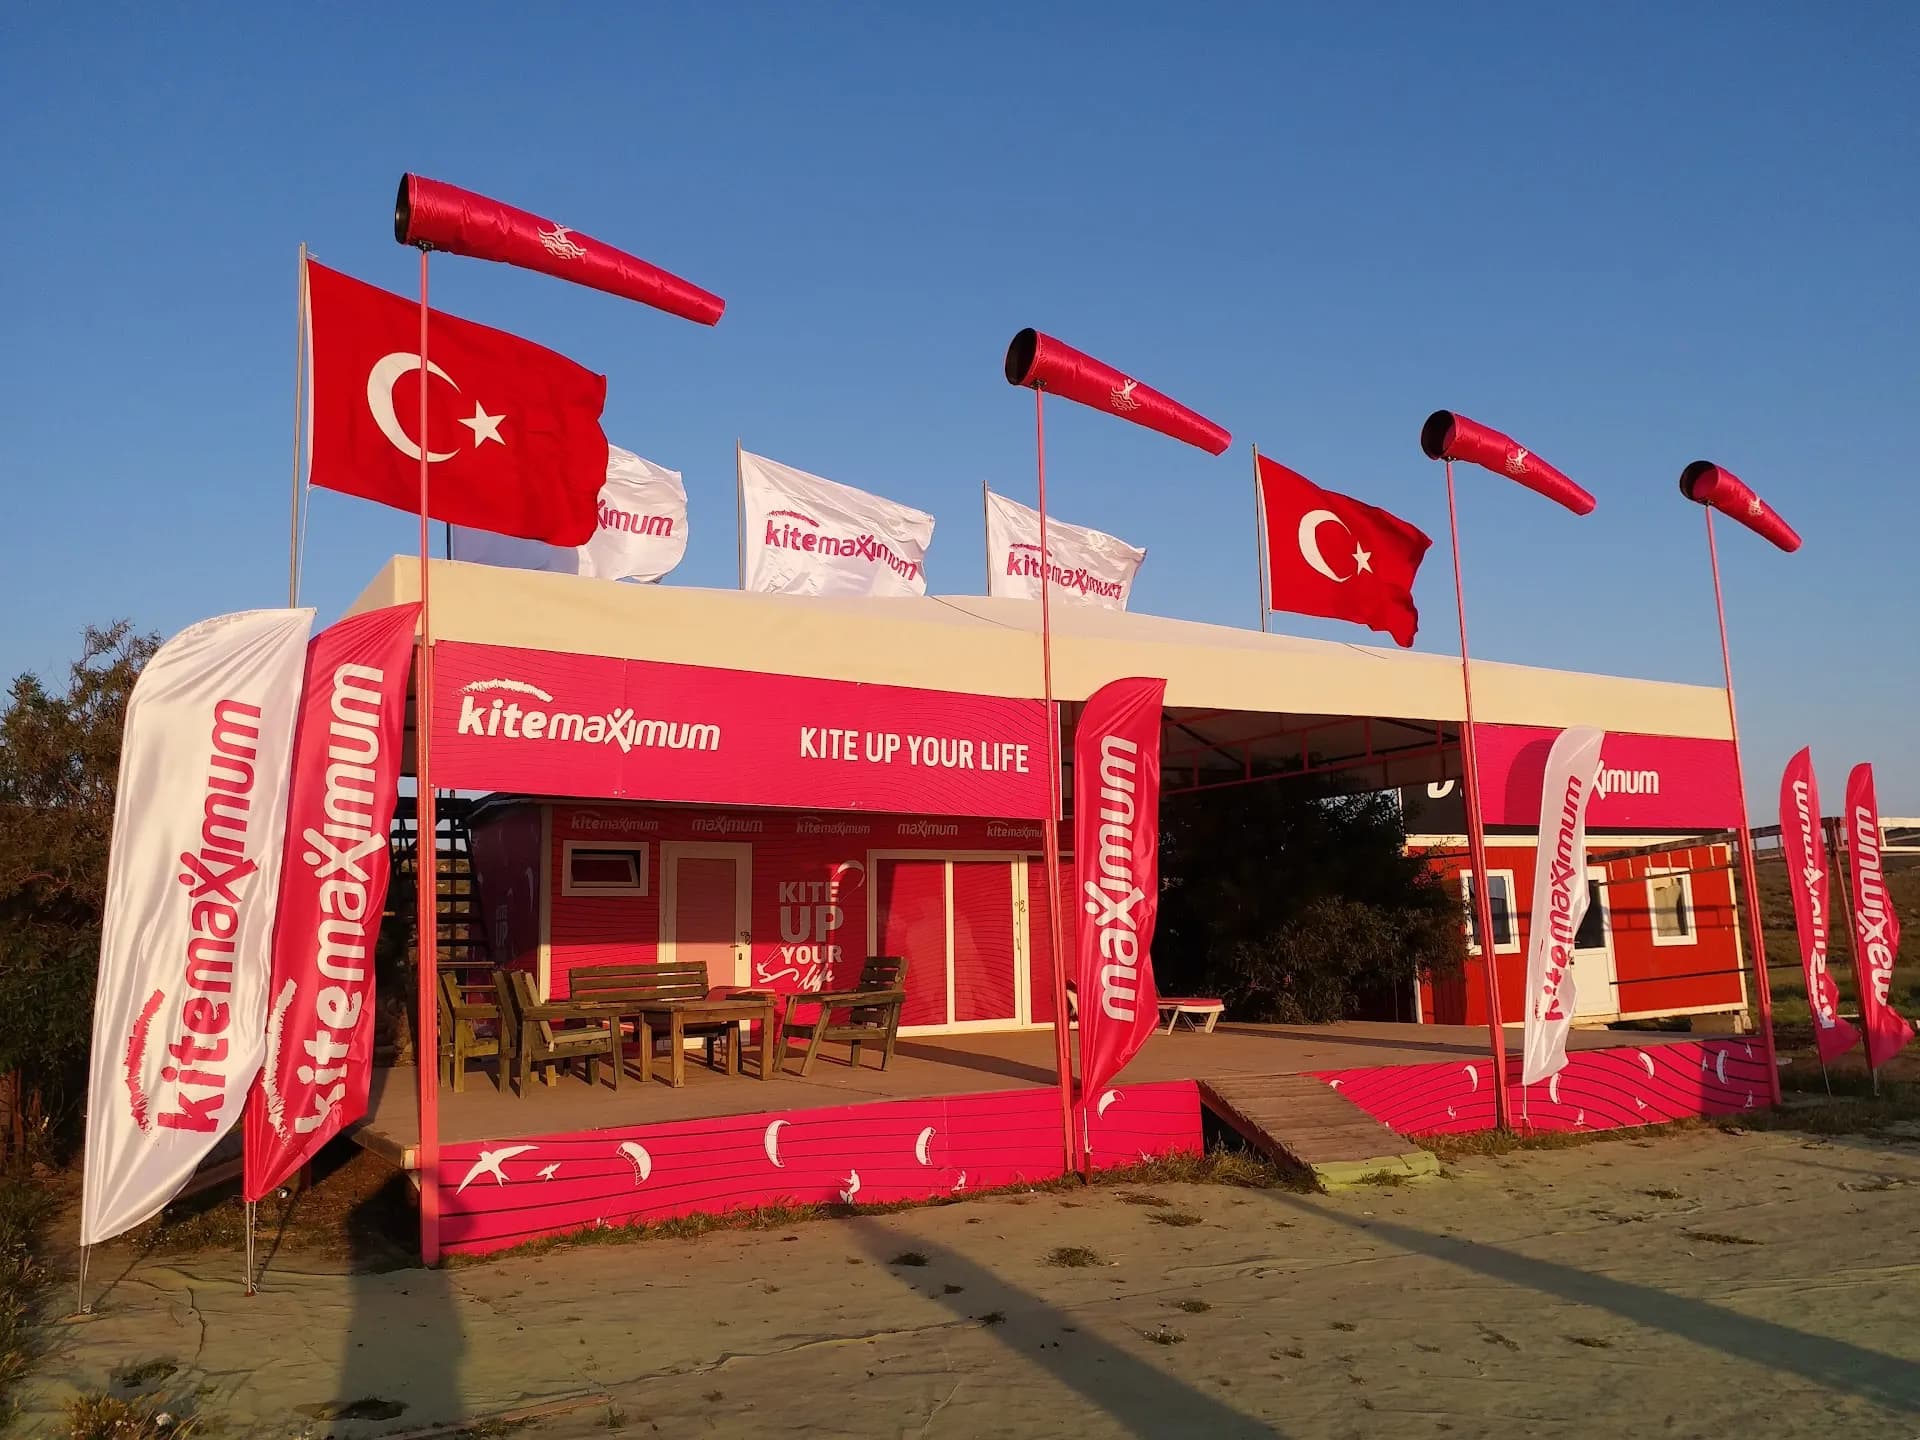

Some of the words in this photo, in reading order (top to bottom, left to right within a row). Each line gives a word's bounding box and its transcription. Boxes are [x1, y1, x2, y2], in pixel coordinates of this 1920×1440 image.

[598, 499, 673, 537] imum
[800, 726, 859, 761] KITE
[866, 732, 901, 763] UP
[907, 735, 974, 769] YOUR
[980, 741, 1029, 773] LIFE
[779, 881, 840, 903] KITE
[780, 905, 844, 943] UP
[781, 944, 843, 965] YOUR
